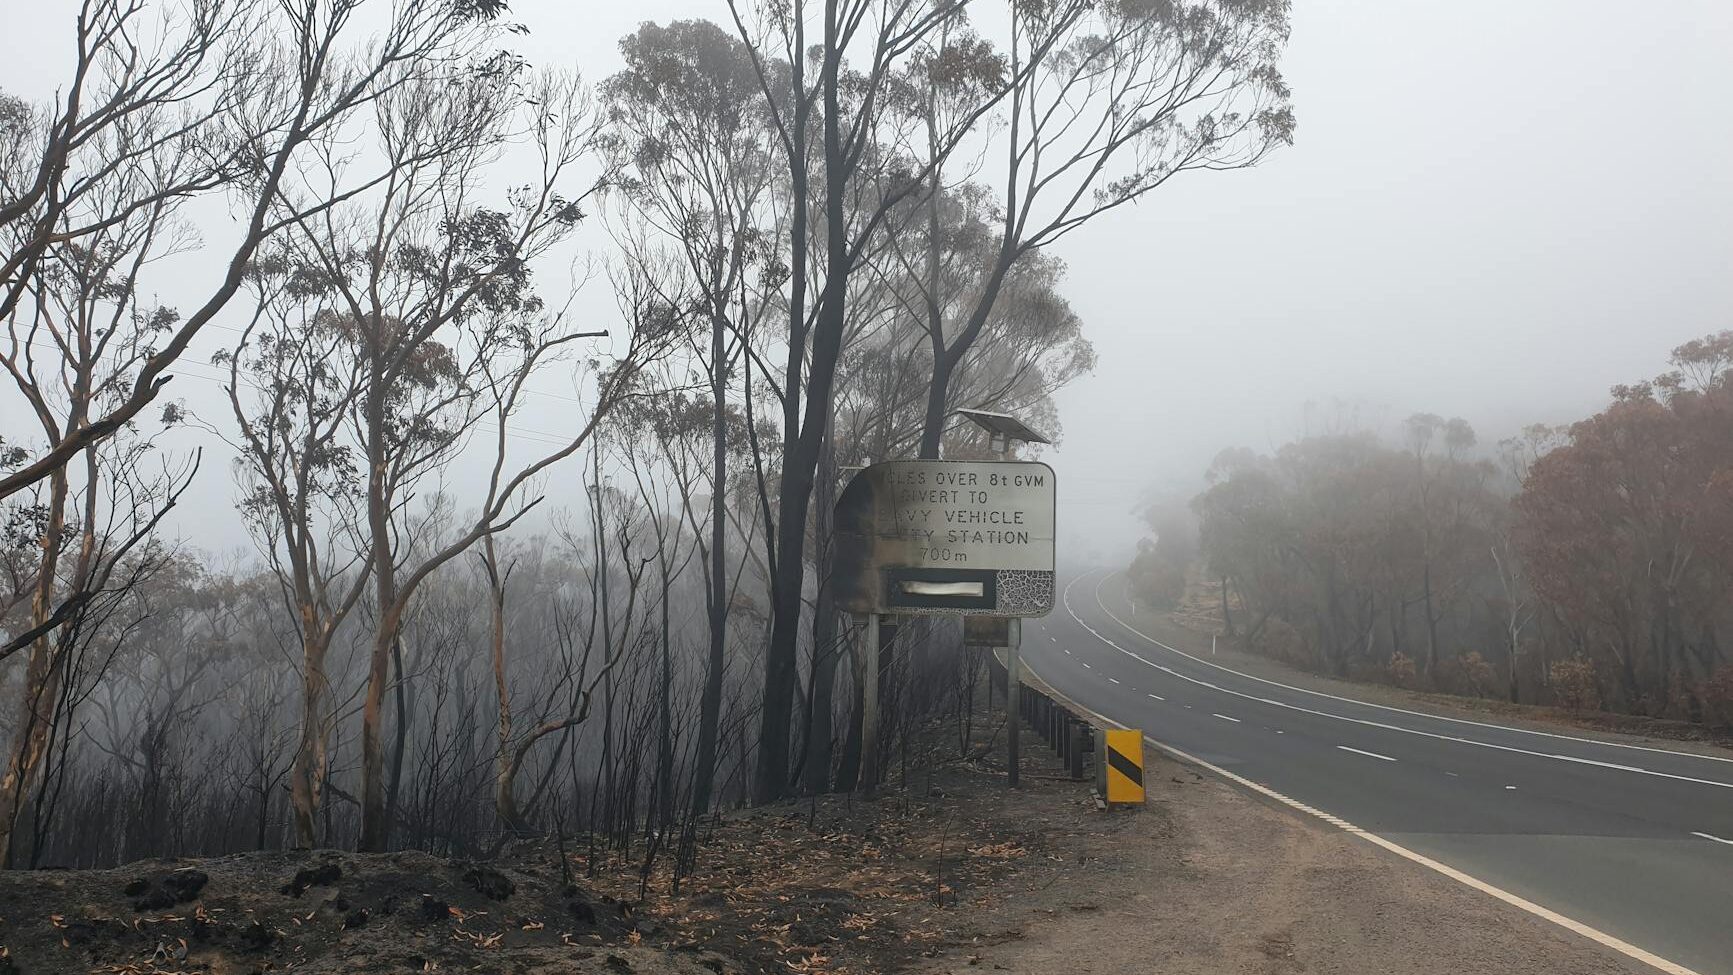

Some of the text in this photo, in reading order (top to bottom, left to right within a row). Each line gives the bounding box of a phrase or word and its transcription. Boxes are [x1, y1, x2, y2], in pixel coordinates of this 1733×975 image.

[935, 472, 978, 486] OVER
[989, 473, 1008, 487] 8t
[1014, 475, 1045, 488] GVM
[969, 490, 988, 504] TO
[944, 510, 1025, 525] VEHICLE
[948, 529, 1029, 545] STATION
[920, 547, 968, 562] 700m
